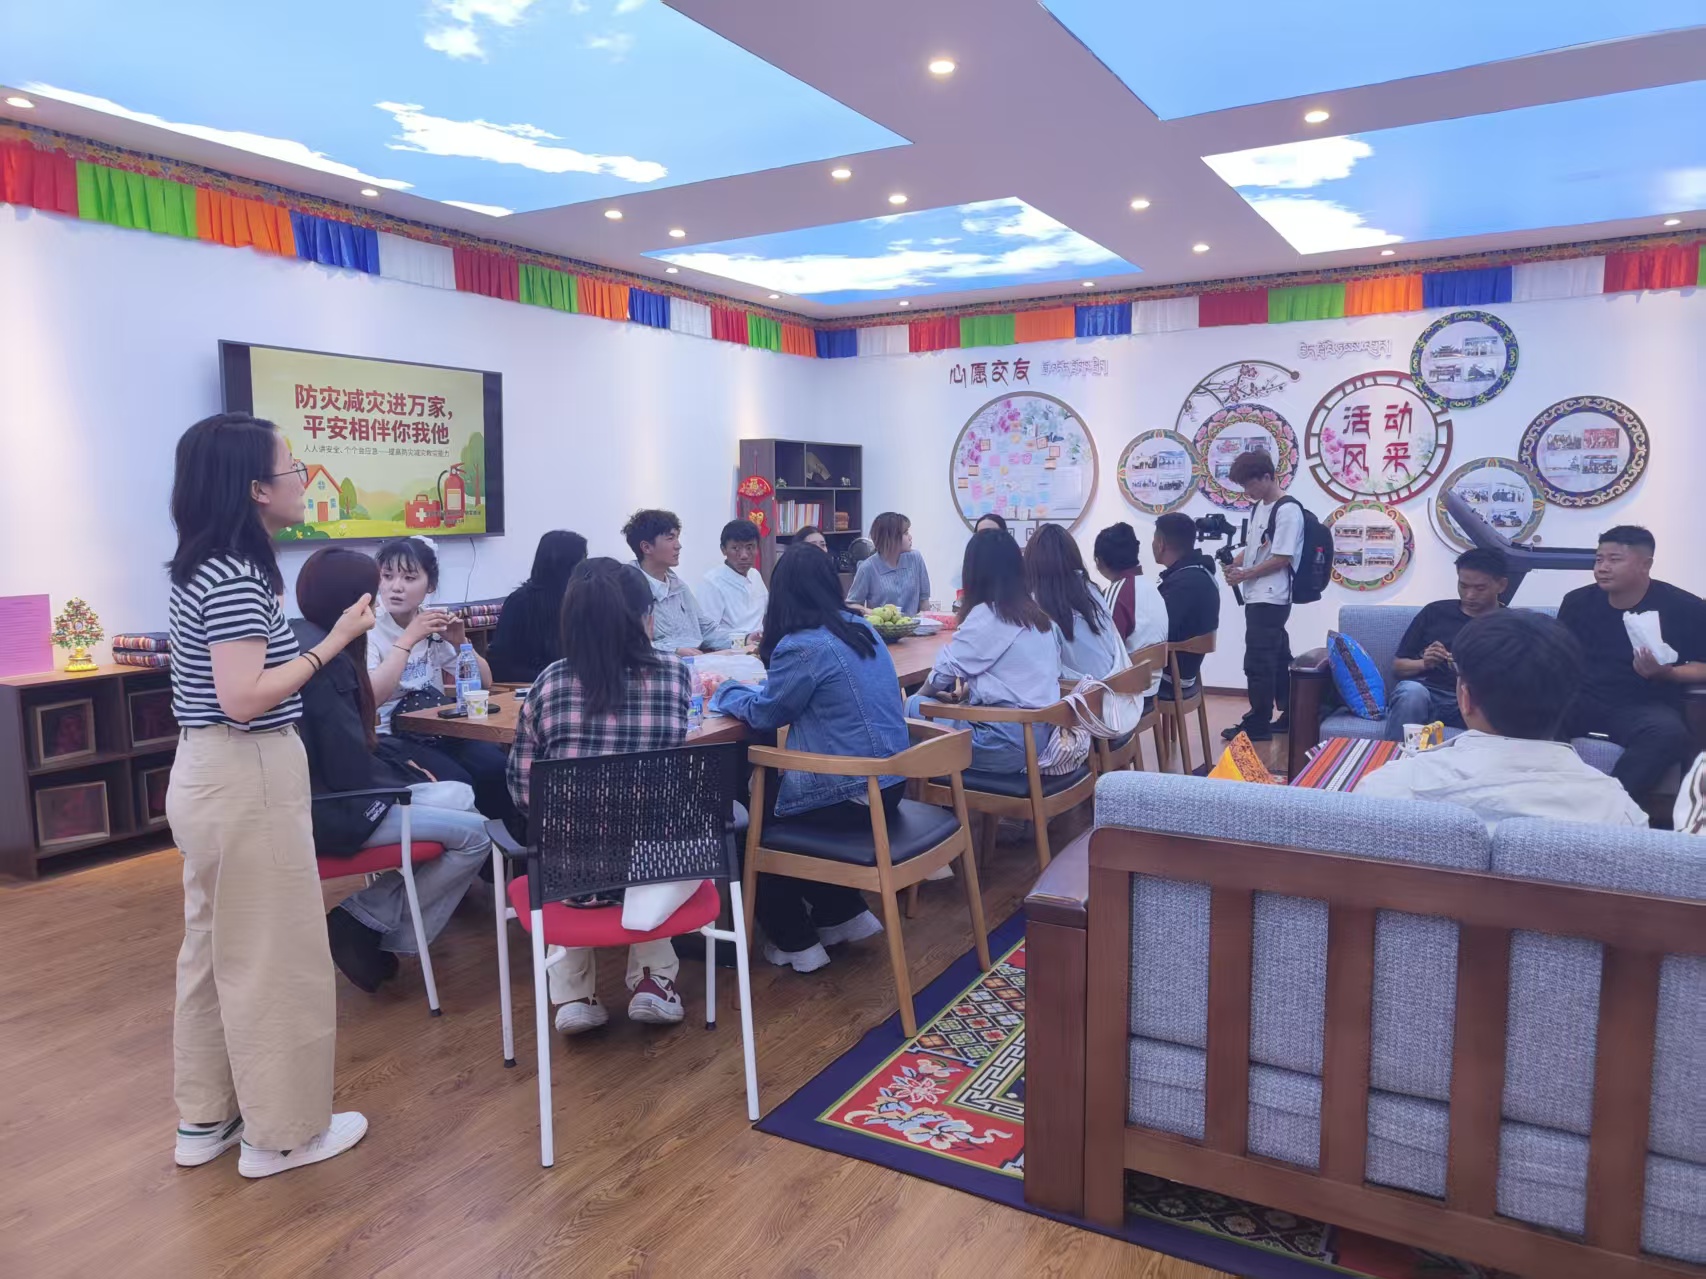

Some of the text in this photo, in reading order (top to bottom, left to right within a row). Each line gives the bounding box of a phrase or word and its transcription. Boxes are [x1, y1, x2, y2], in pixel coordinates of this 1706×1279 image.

[949, 357, 1030, 388] 心愿交友
[294, 383, 453, 420] 防灾减灾进万家，
[1342, 400, 1413, 440] 活动
[303, 415, 450, 445] 平安相伴你我他
[1342, 442, 1411, 480] 风采
